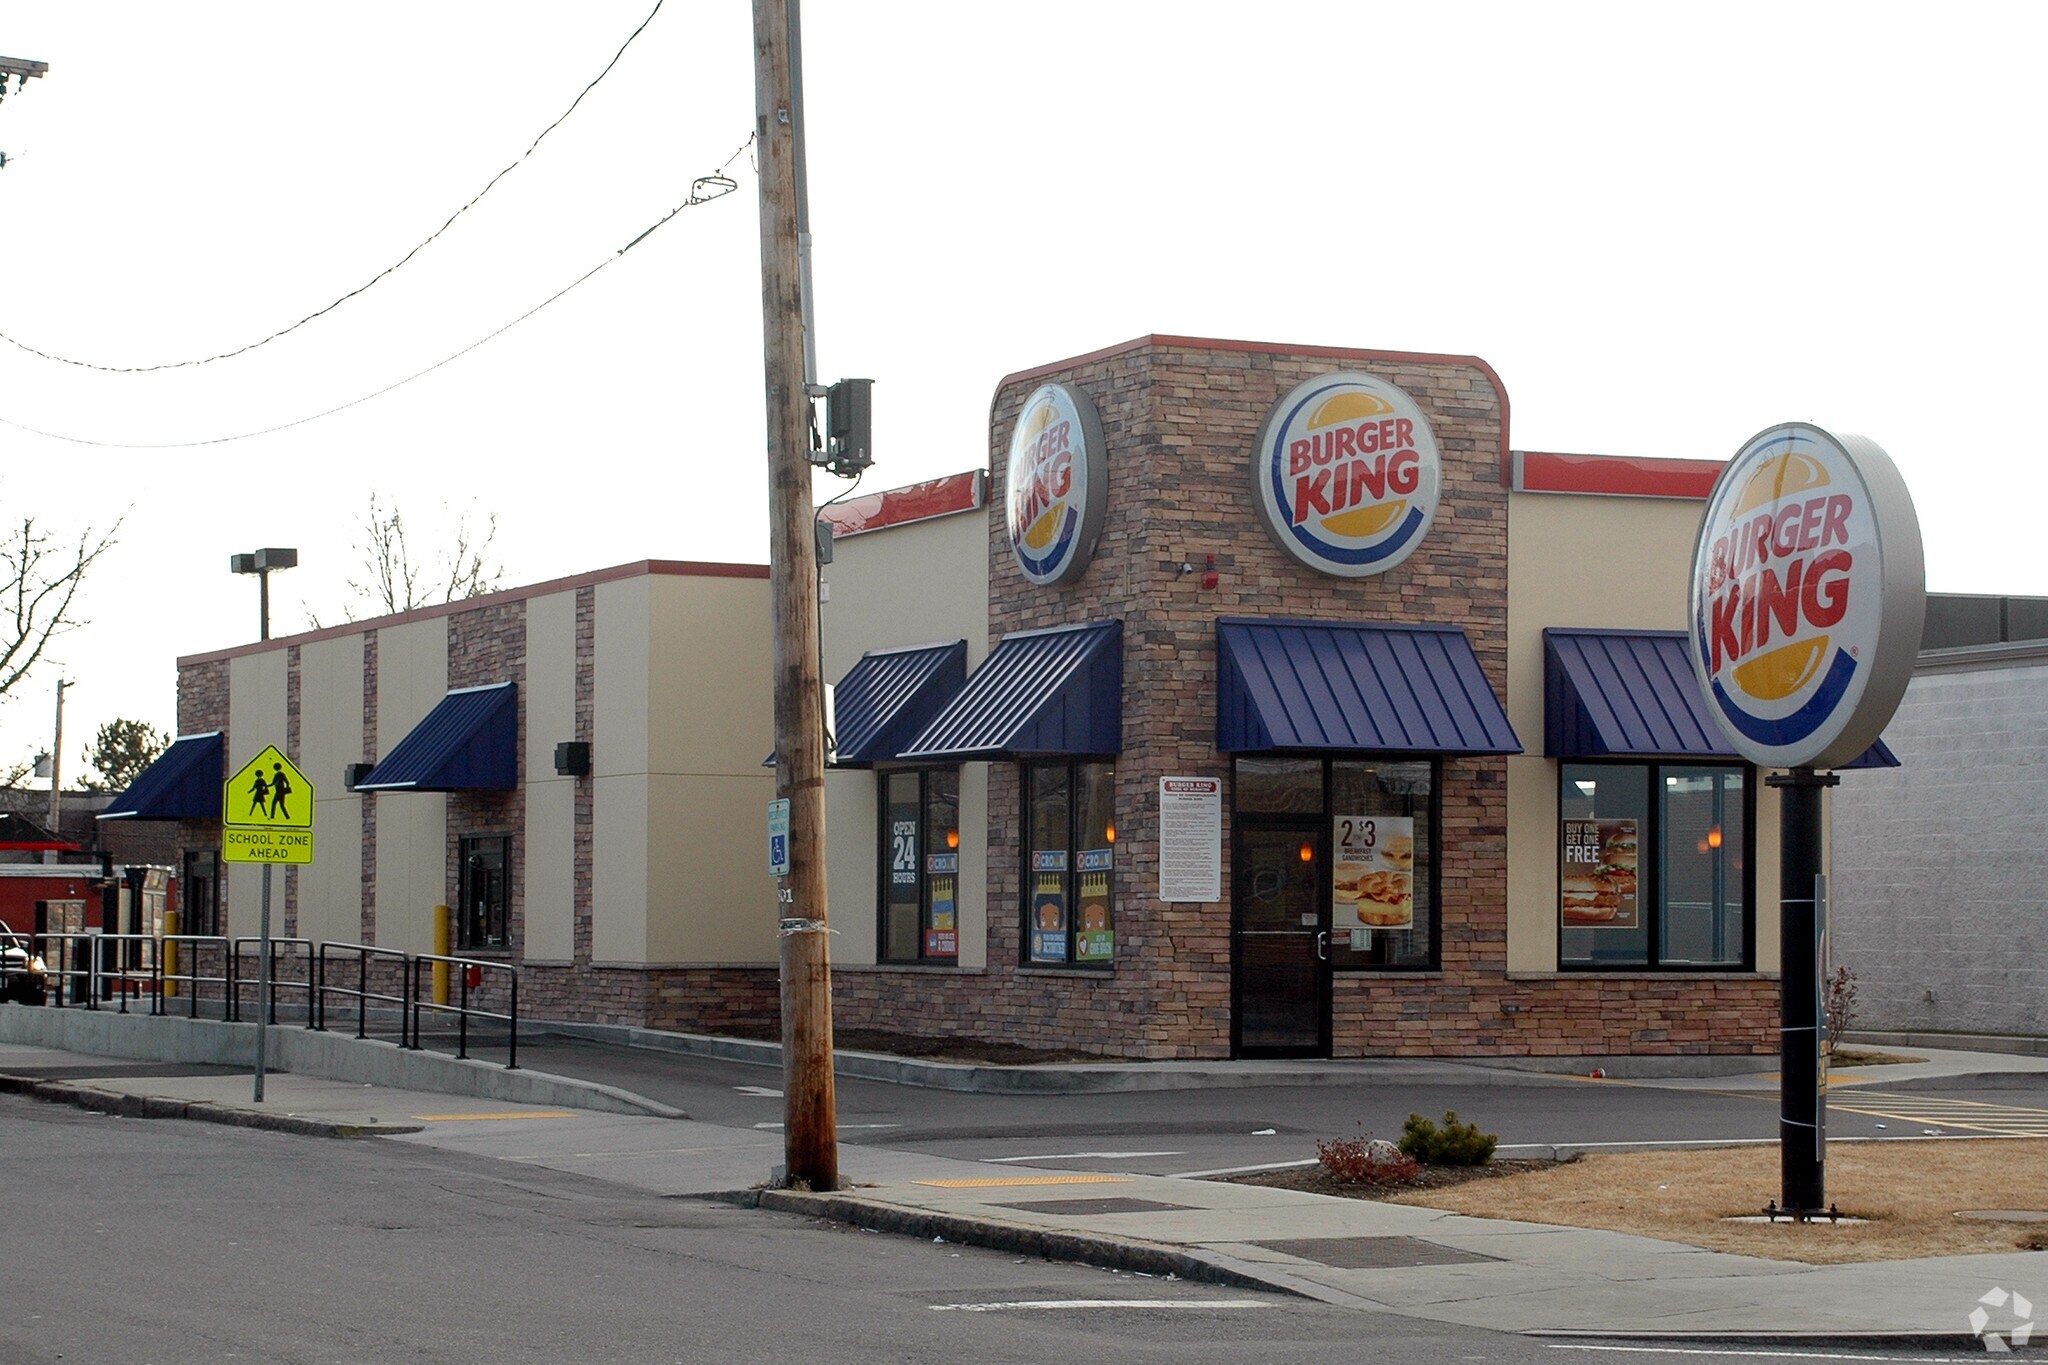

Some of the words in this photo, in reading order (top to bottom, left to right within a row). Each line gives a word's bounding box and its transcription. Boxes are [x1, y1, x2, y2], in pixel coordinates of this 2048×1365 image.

[1289, 418, 1414, 477] BURGER
[1293, 451, 1419, 527] KING
[1708, 494, 1852, 597] BURGER
[1711, 550, 1852, 679] KING
[893, 821, 916, 836] OPEN
[1341, 819, 1353, 847] 2
[1566, 823, 1581, 834] BUY
[1583, 823, 1600, 834] ONE
[228, 834, 273, 845] SCHOOL
[279, 835, 309, 846] ZONE
[1566, 834, 1581, 845] GET
[1583, 834, 1600, 845] ONE
[249, 848, 289, 858] AHEAD
[893, 836, 916, 869] 24
[1342, 854, 1374, 862] SANDWICHES
[1344, 847, 1372, 855] BREAKFAST
[1565, 845, 1600, 863] FREE
[893, 872, 916, 883] HOURS
